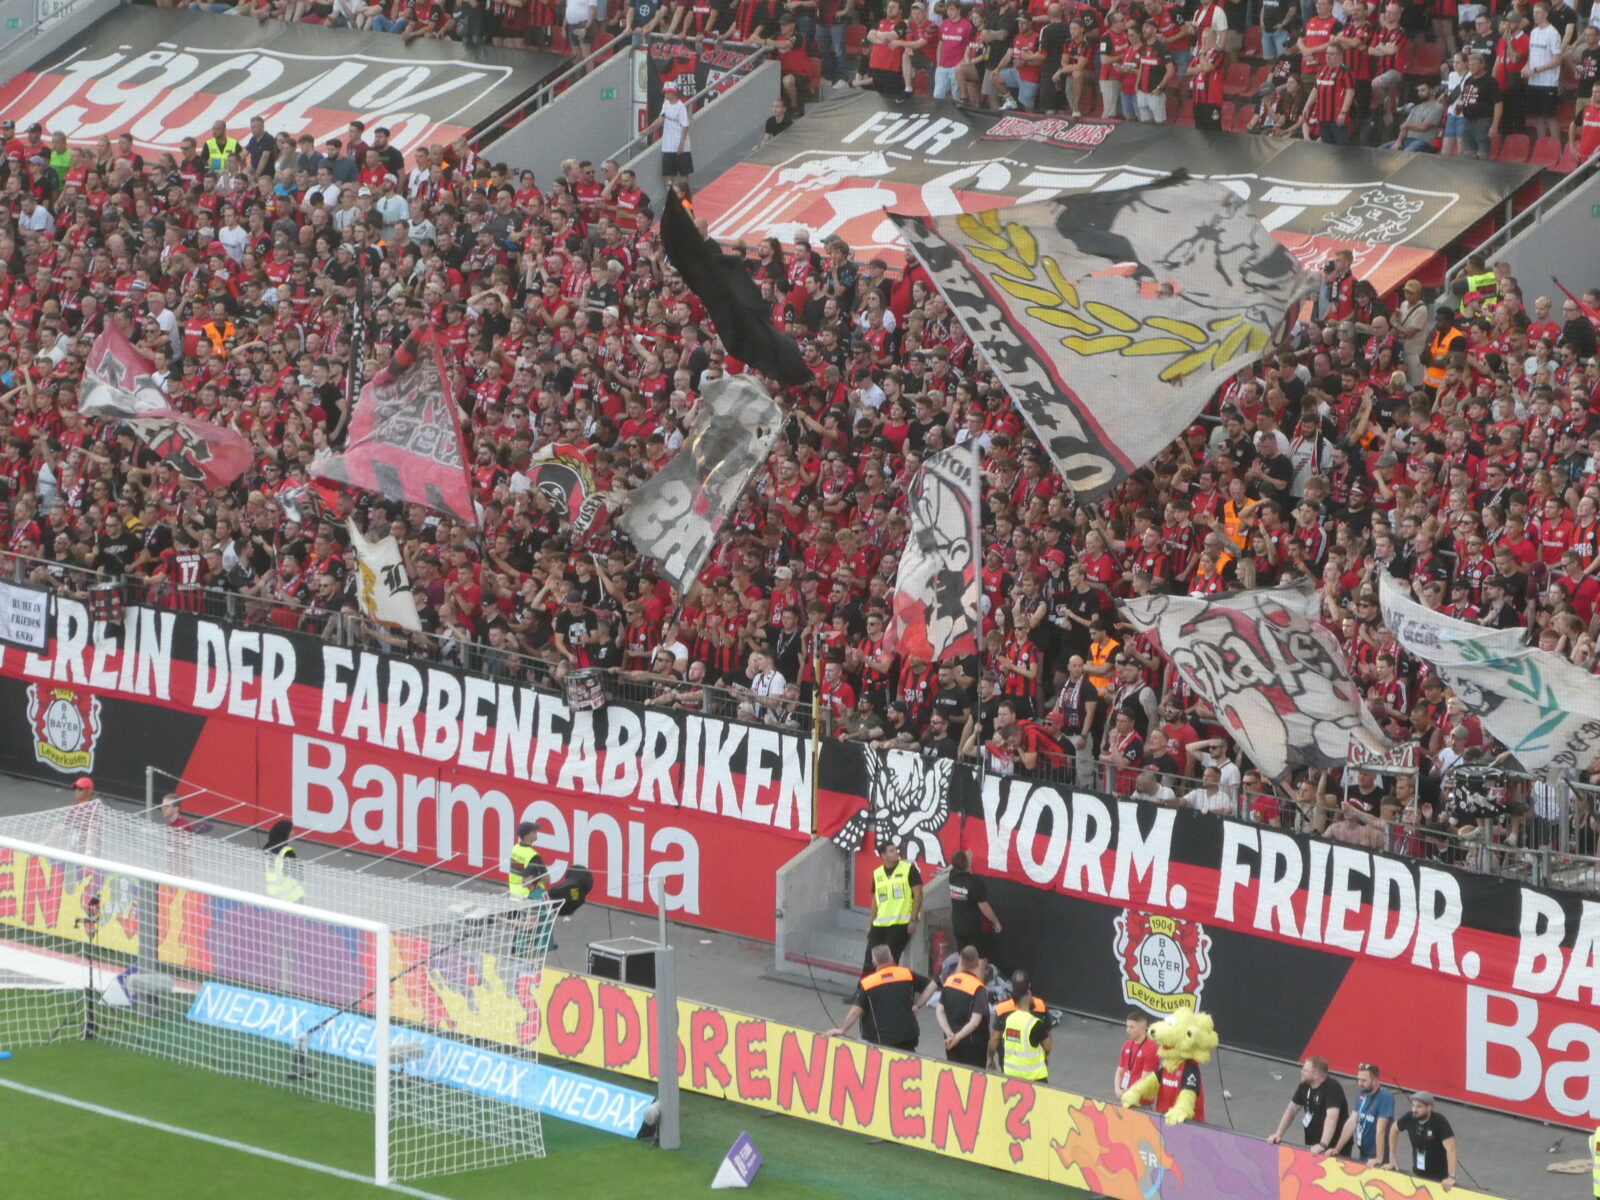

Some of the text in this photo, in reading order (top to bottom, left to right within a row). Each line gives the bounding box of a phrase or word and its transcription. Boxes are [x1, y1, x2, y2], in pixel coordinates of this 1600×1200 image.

[842, 111, 968, 156] FÜR
[181, 562, 198, 584] 17
[50, 718, 78, 731] BAYER
[41, 744, 87, 766] Leverkusen
[194, 620, 296, 726] DER
[317, 644, 822, 834] FARBENFABRIKEN
[981, 774, 1187, 909] VORM.
[1214, 821, 1480, 979] FRIEDR.
[292, 733, 699, 914] Barmenia
[1152, 919, 1173, 933] 1904
[1143, 956, 1180, 972] BAYER
[194, 985, 308, 1039] NIEDAX
[1131, 984, 1191, 1010] Leverkusen
[424, 1043, 529, 1098] NIEDAX
[1466, 985, 1600, 1119] Ba
[539, 1075, 646, 1132] NIEDAX
